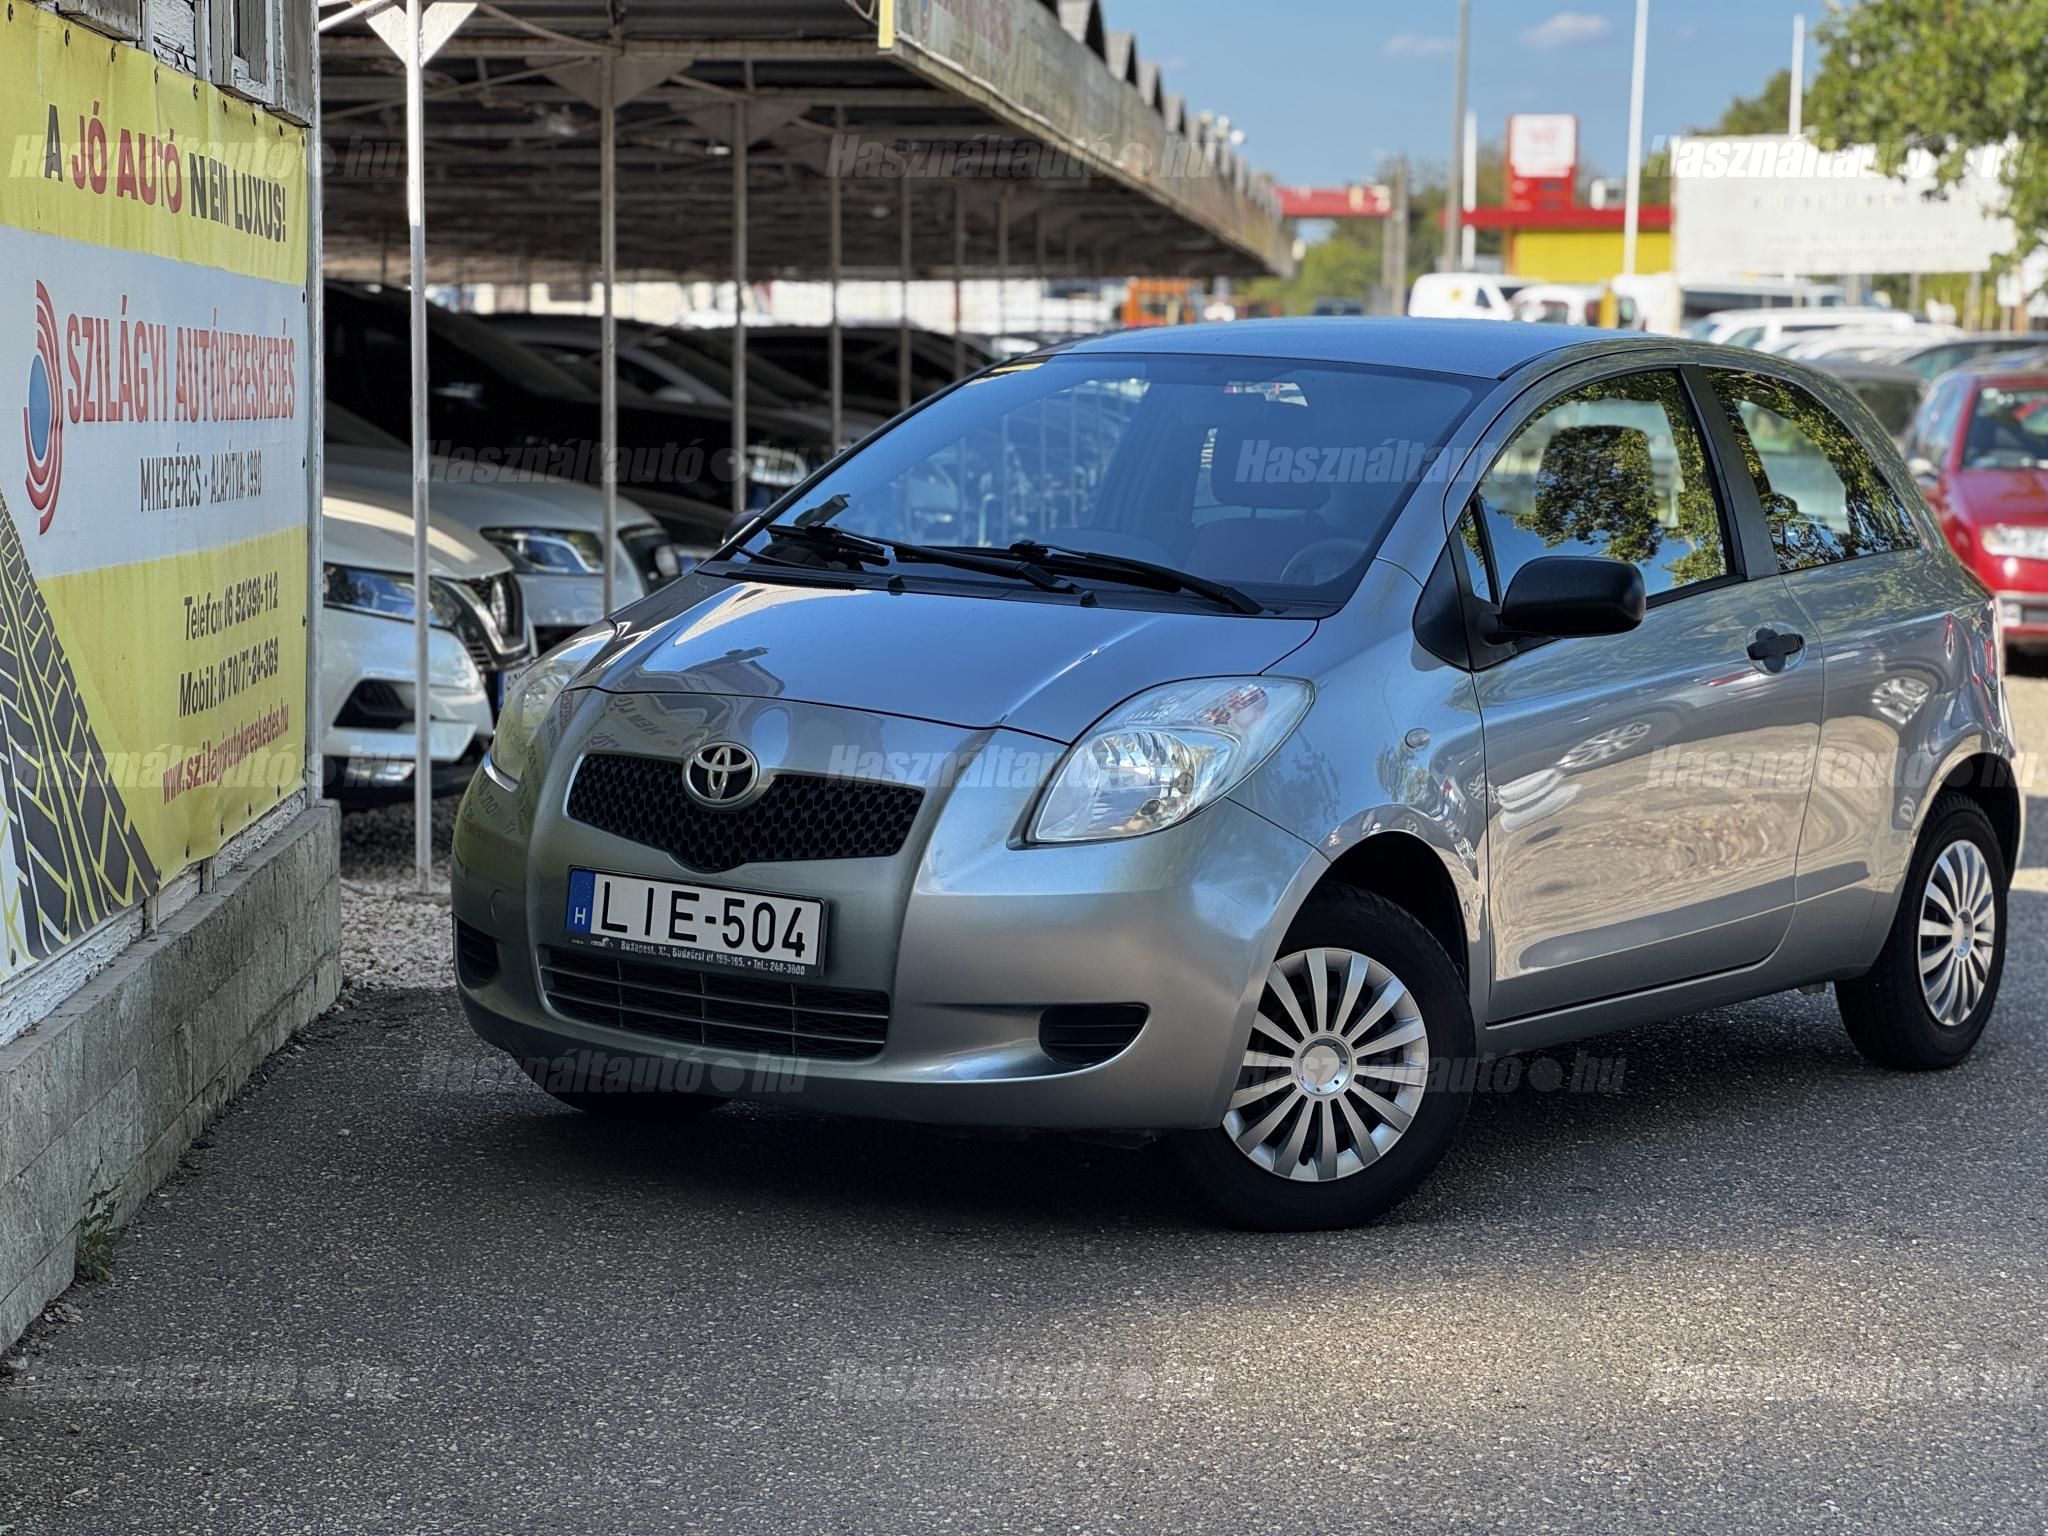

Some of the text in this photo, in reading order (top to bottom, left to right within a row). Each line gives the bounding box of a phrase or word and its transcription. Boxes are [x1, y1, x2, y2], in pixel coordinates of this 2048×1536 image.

[44, 101, 287, 243] A JÓ AUTÓ NEM LUXUS!
[66, 294, 295, 424] SZILÁGYI AUTÓKERESKEDÉS
[140, 441, 201, 512] MIKEPÉRCS
[179, 665, 217, 718] Mobil:
[574, 906, 586, 925] H
[600, 881, 806, 957] LIE-504
